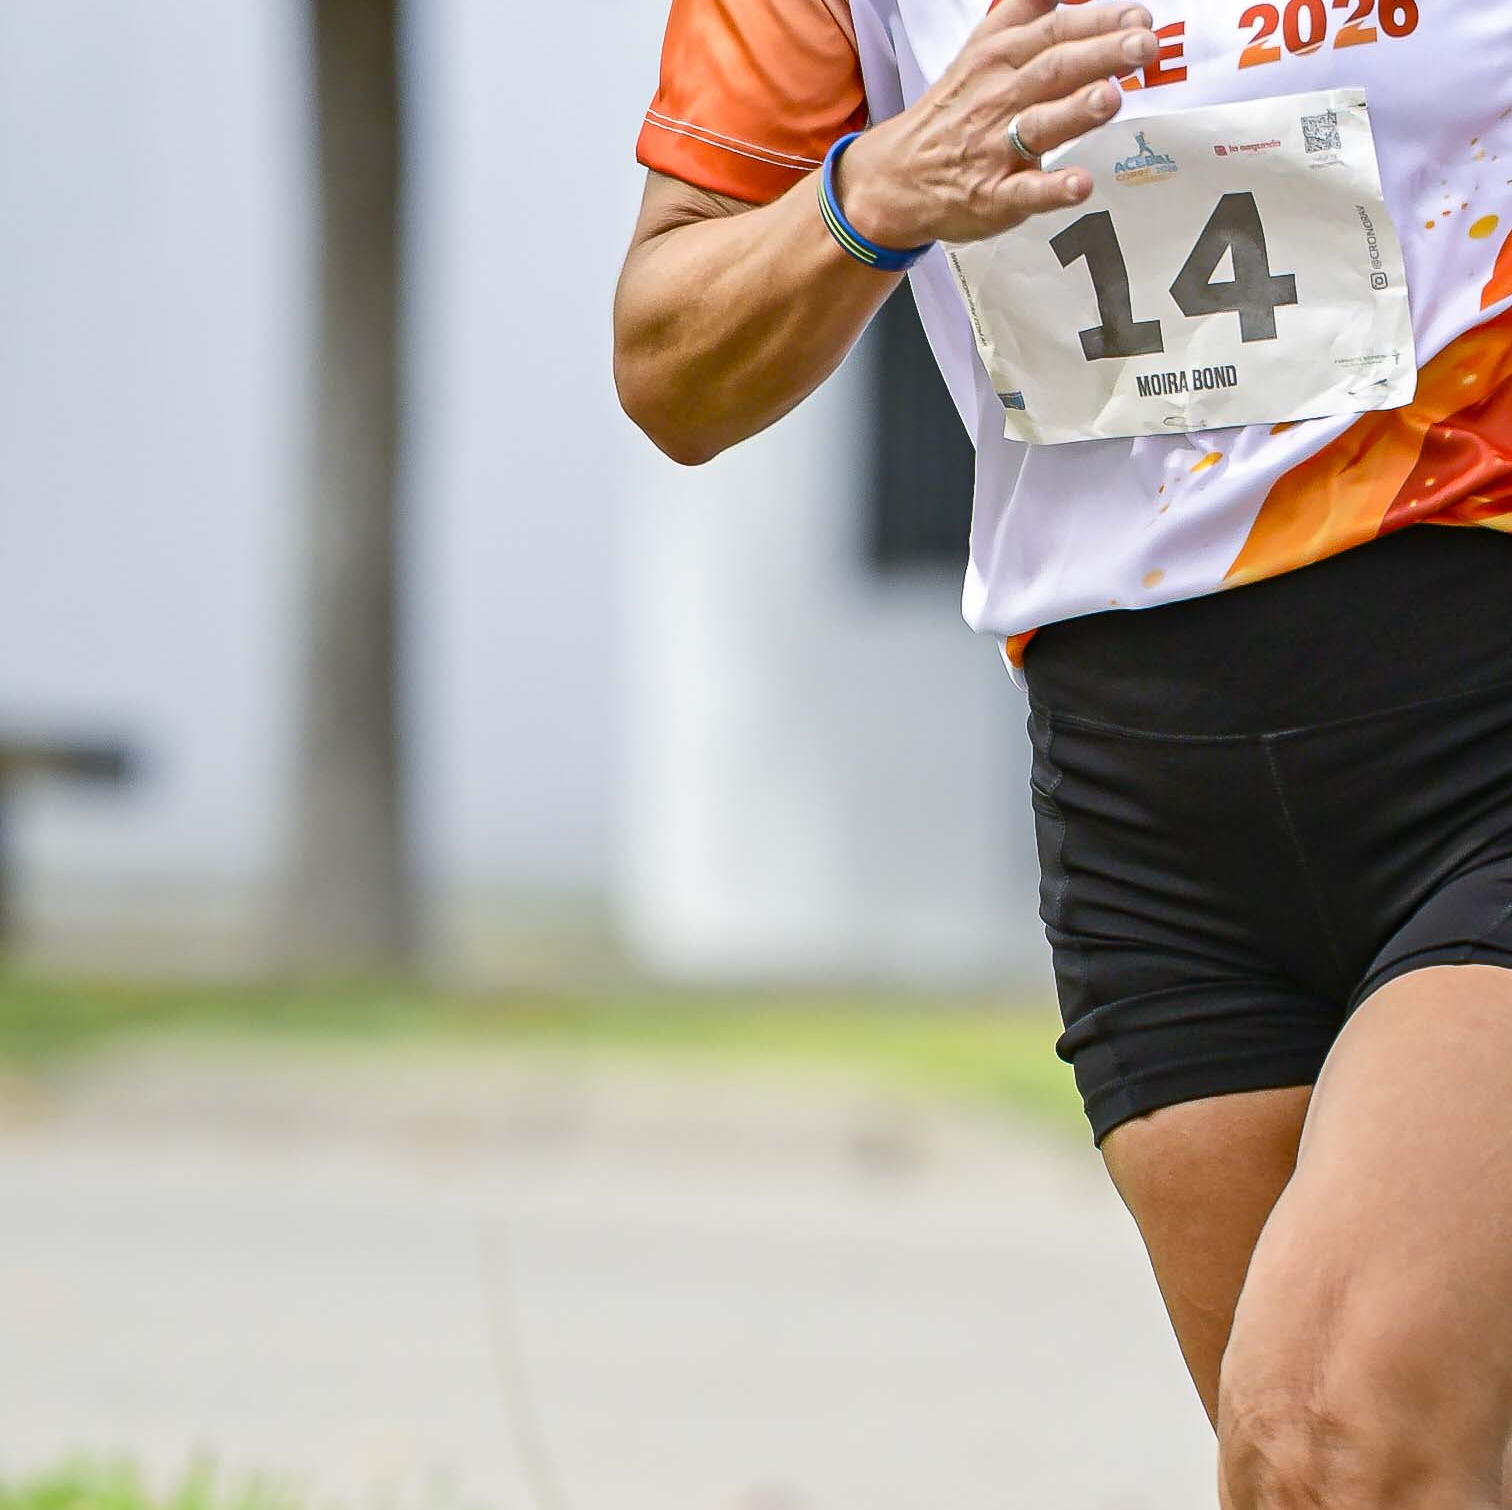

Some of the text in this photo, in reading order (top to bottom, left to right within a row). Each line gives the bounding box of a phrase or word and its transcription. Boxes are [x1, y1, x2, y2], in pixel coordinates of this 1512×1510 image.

[1048, 191, 1298, 362] 14
[1136, 364, 1238, 398] MOIRA BOND
